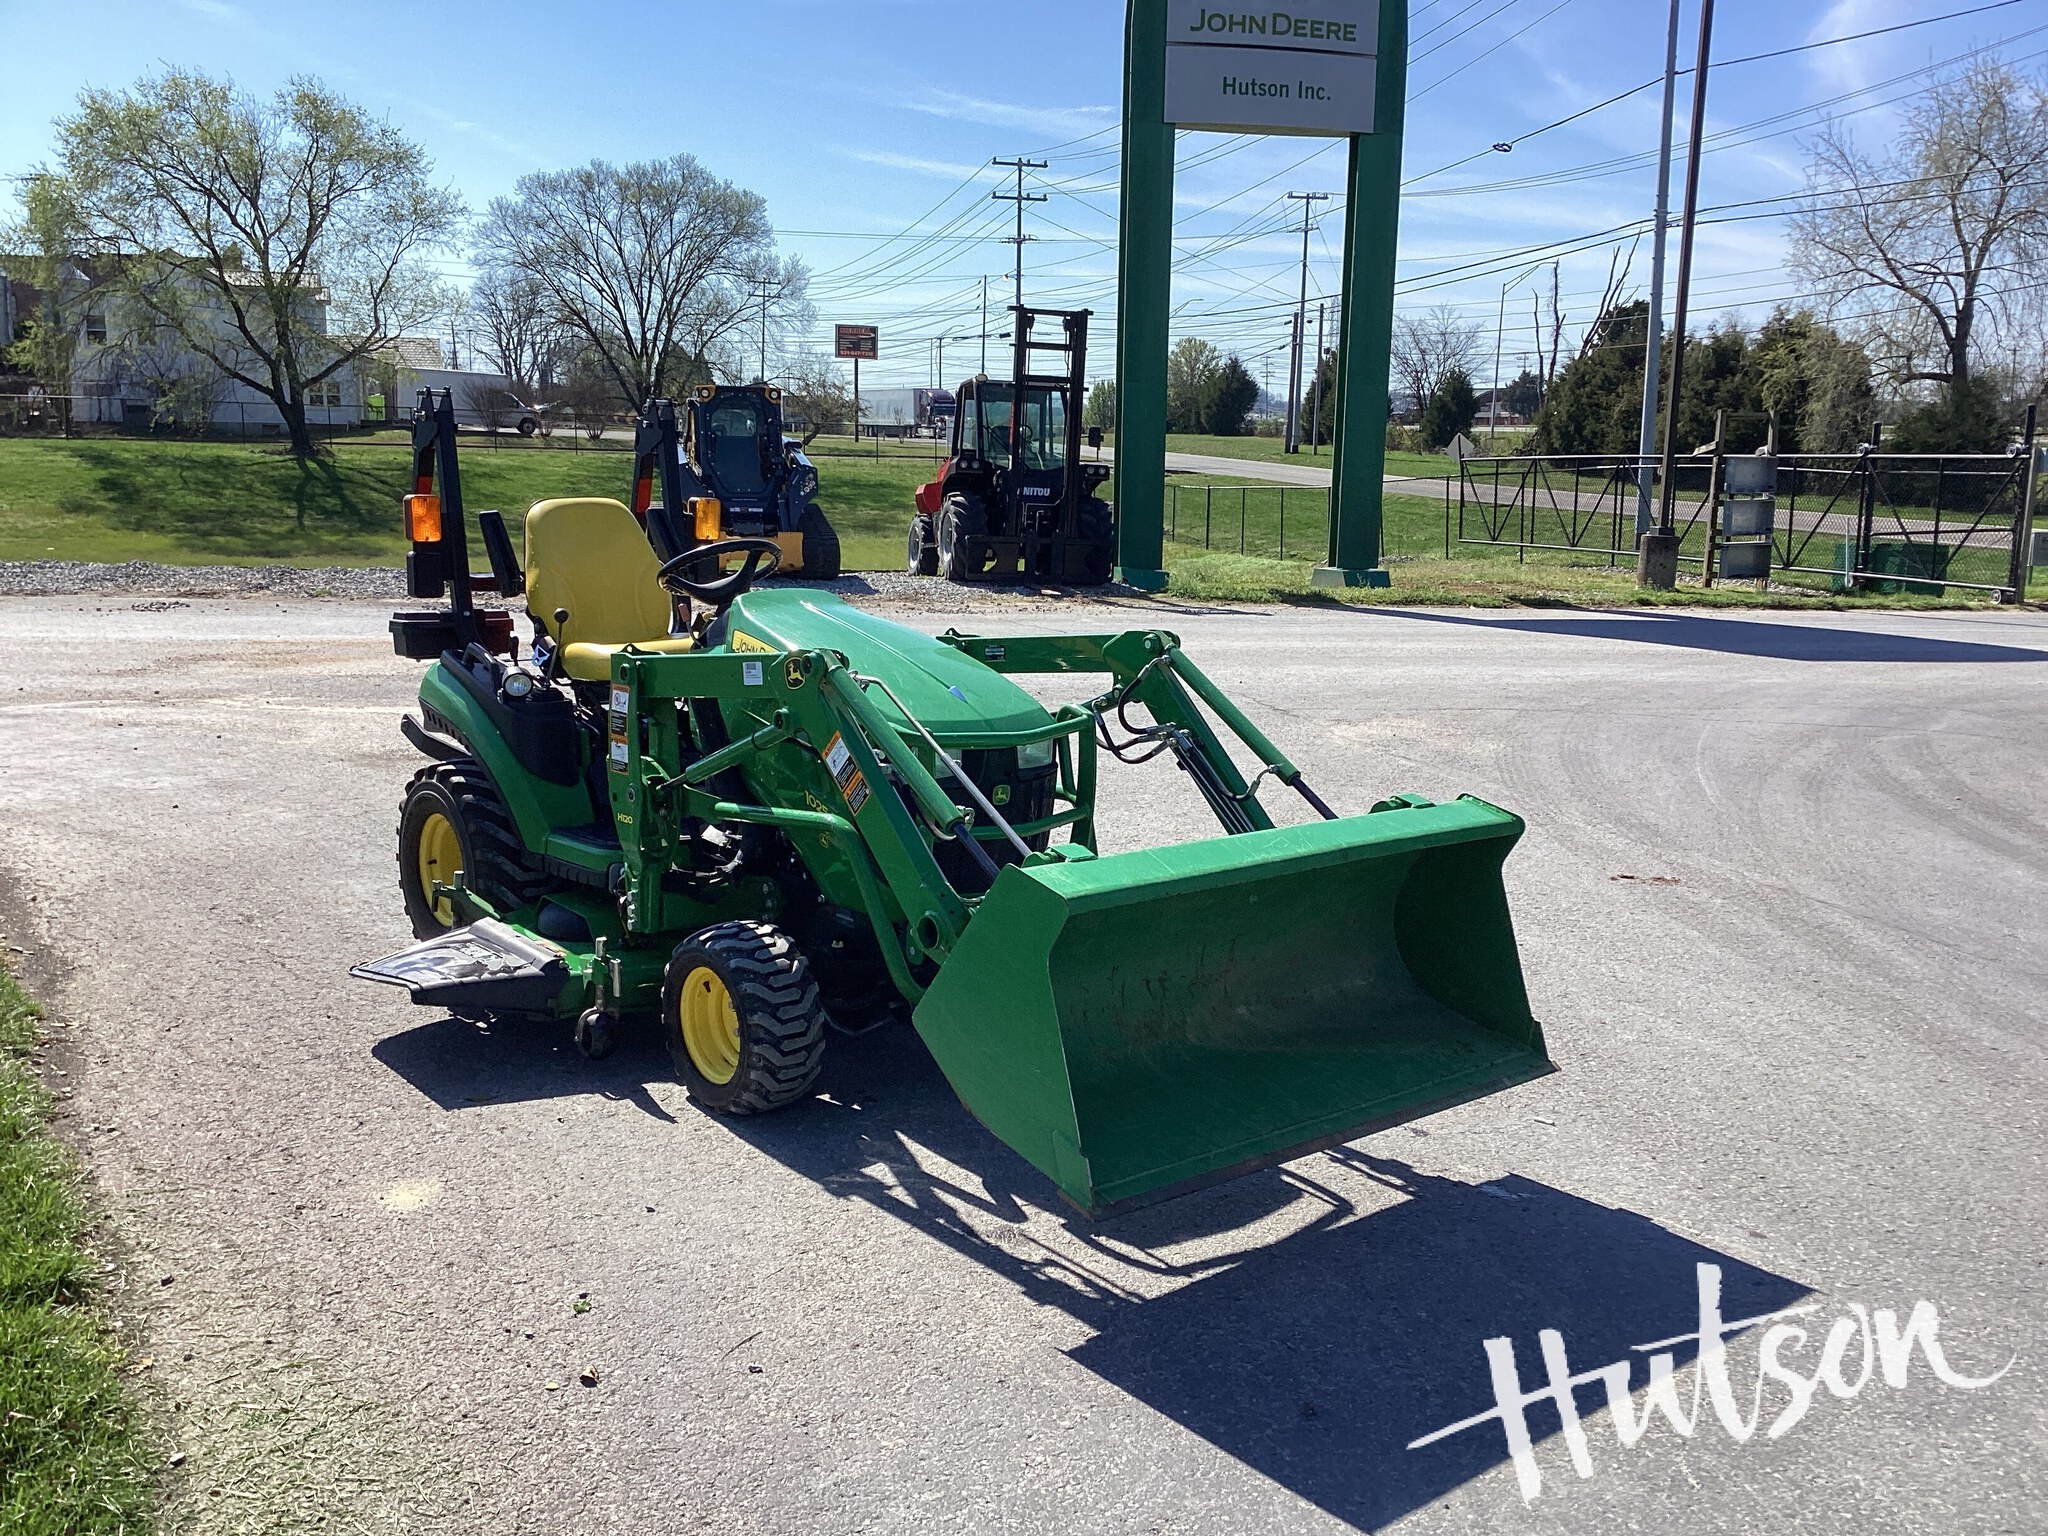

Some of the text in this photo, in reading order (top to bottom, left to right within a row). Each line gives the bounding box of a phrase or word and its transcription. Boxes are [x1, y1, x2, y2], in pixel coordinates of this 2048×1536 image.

[1190, 9, 1357, 42] JOHN DEERE
[1222, 76, 1331, 101] Hutson Inc.
[617, 812, 633, 825] H120
